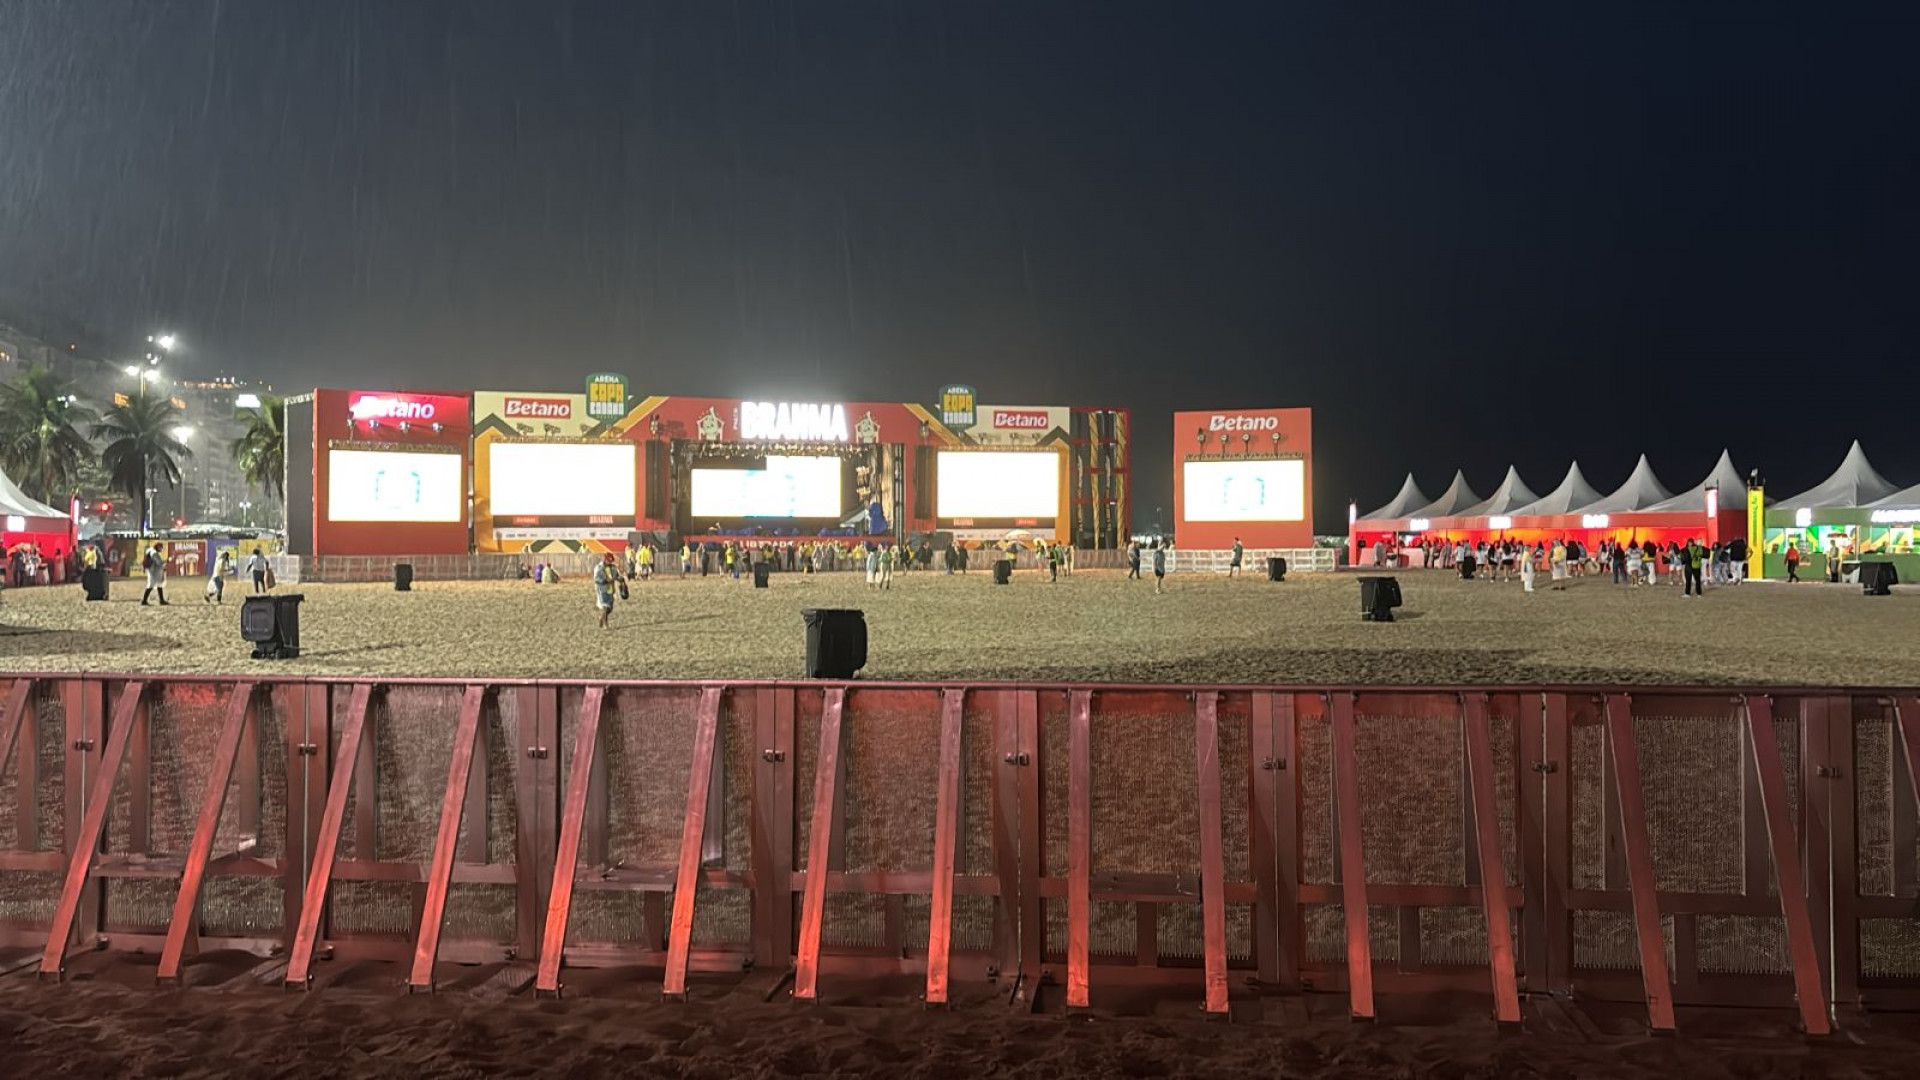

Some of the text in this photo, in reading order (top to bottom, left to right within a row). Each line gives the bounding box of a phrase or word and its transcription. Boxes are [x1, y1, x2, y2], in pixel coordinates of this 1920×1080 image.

[594, 375, 620, 383] ARENA
[506, 400, 570, 416] Betano
[741, 401, 849, 441] BRAHMA
[995, 413, 1047, 427] Betano
[1209, 415, 1279, 431] Betano
